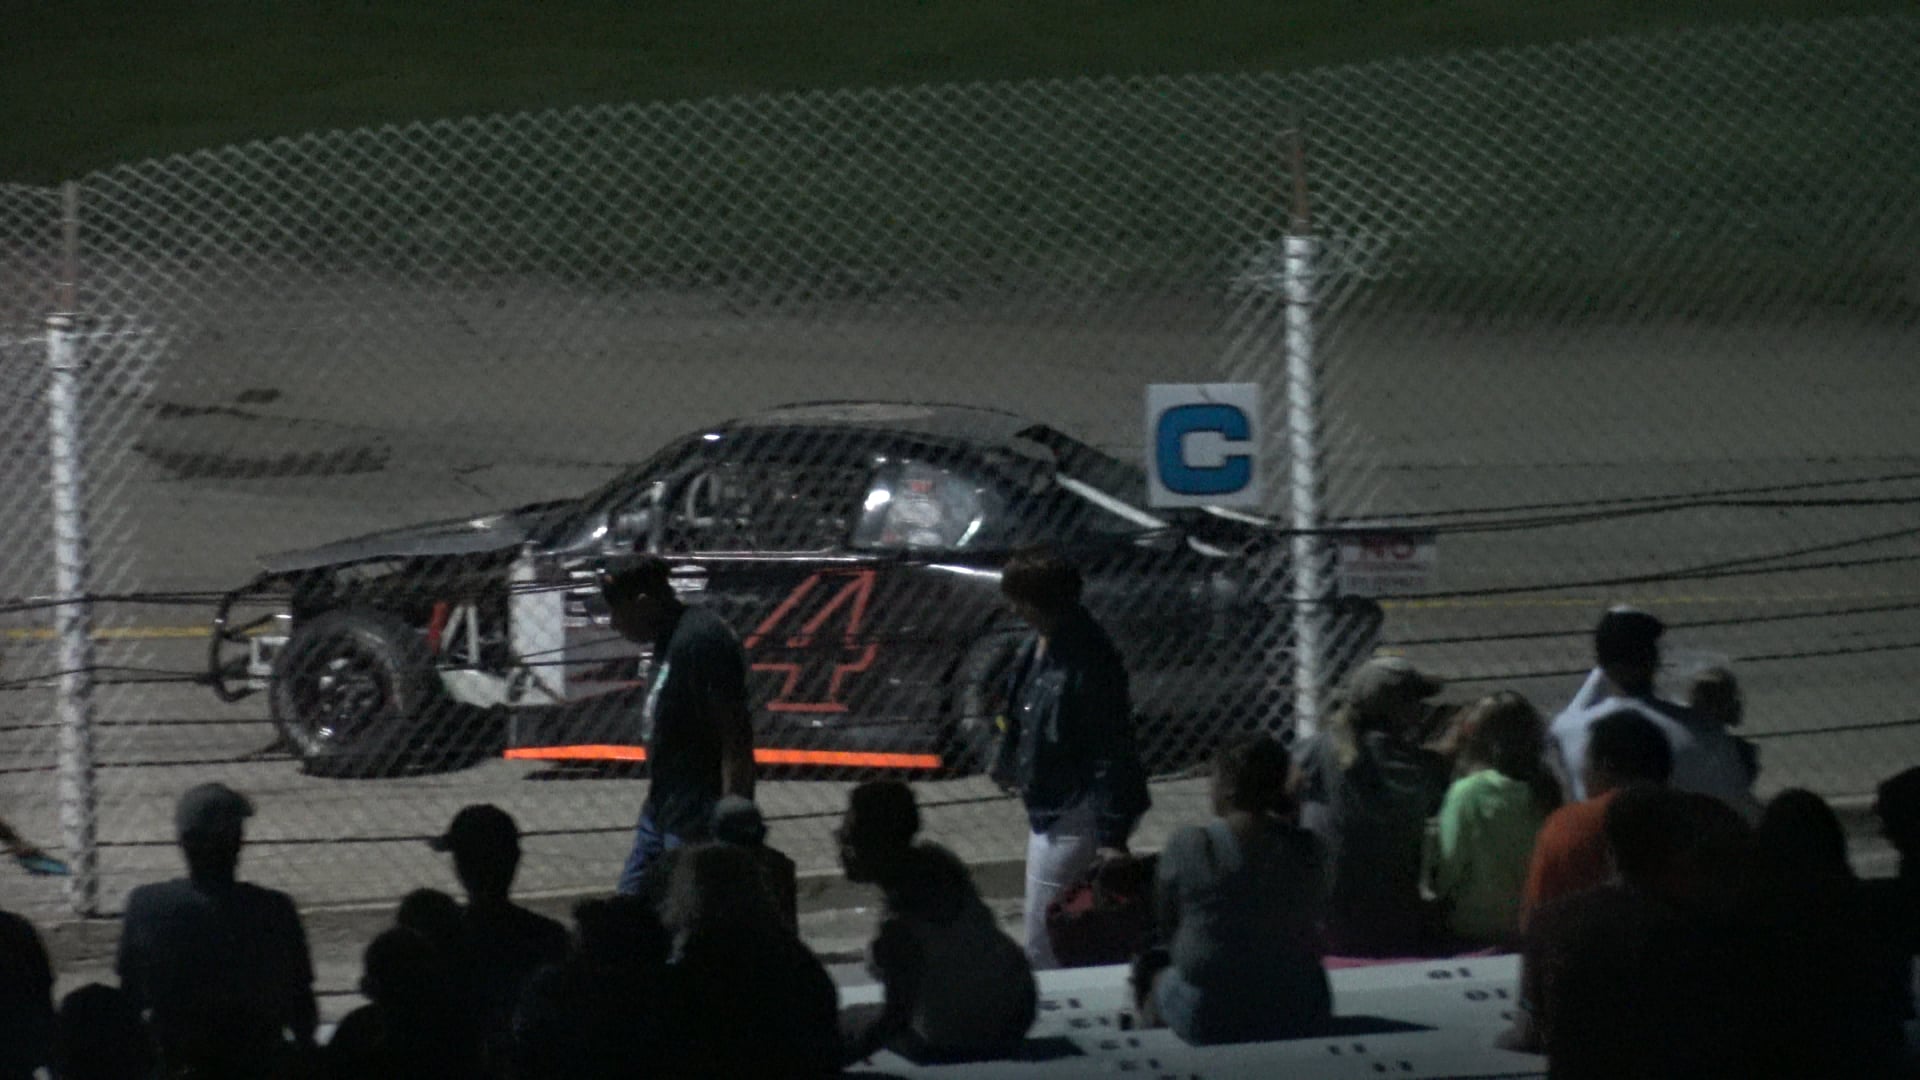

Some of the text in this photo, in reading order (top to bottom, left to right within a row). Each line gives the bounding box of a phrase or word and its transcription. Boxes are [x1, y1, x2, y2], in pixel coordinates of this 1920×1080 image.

[1156, 403, 1251, 495] C
[1361, 532, 1416, 560] NO
[744, 567, 878, 713] 4
